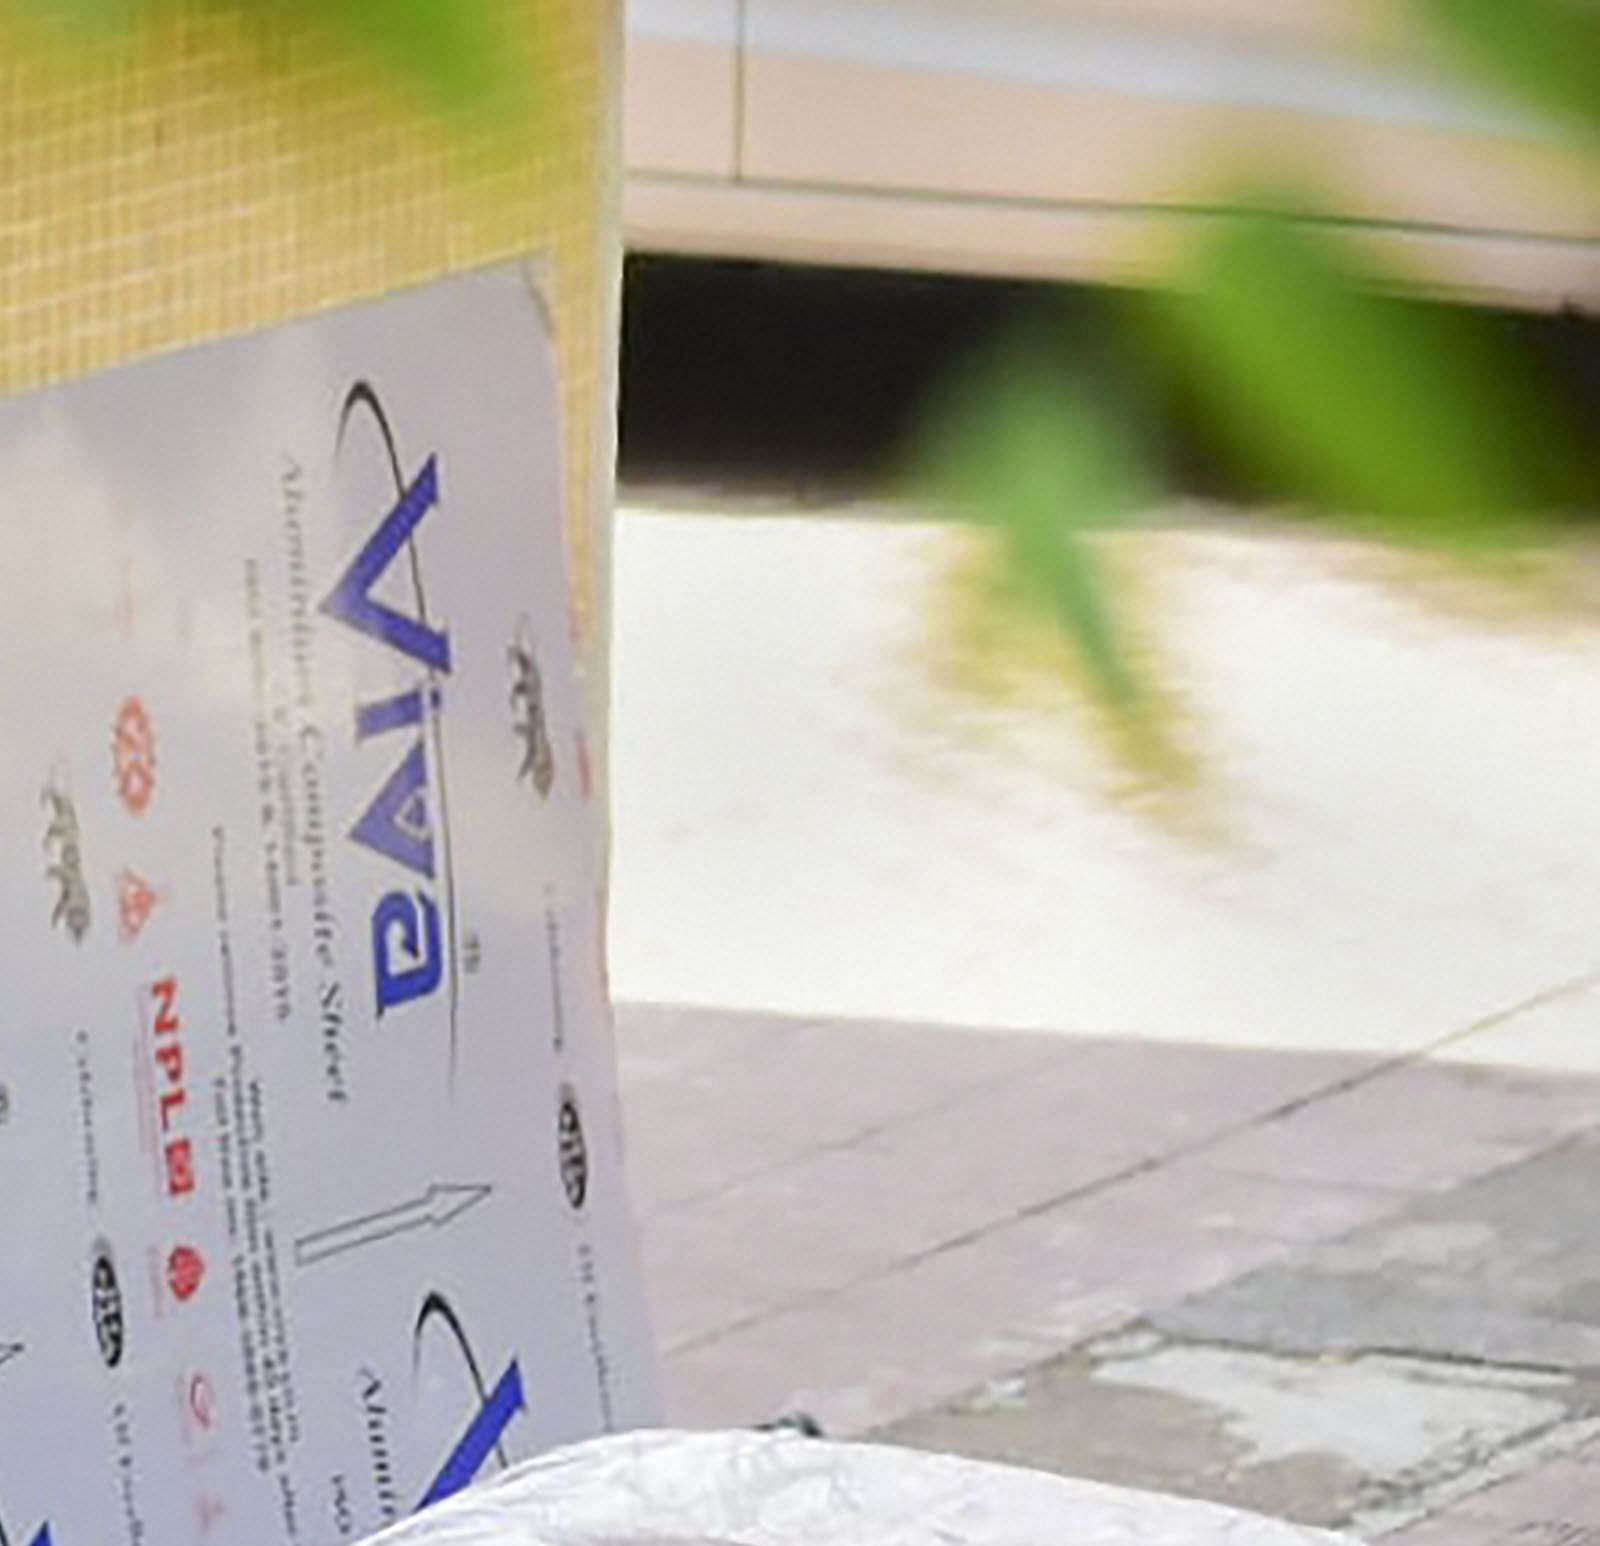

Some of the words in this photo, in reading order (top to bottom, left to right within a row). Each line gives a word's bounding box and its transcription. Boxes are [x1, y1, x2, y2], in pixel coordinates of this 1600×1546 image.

[318, 452, 451, 1018] Viva
[152, 975, 188, 1133] NPL
[317, 980, 349, 1103] Sheet
